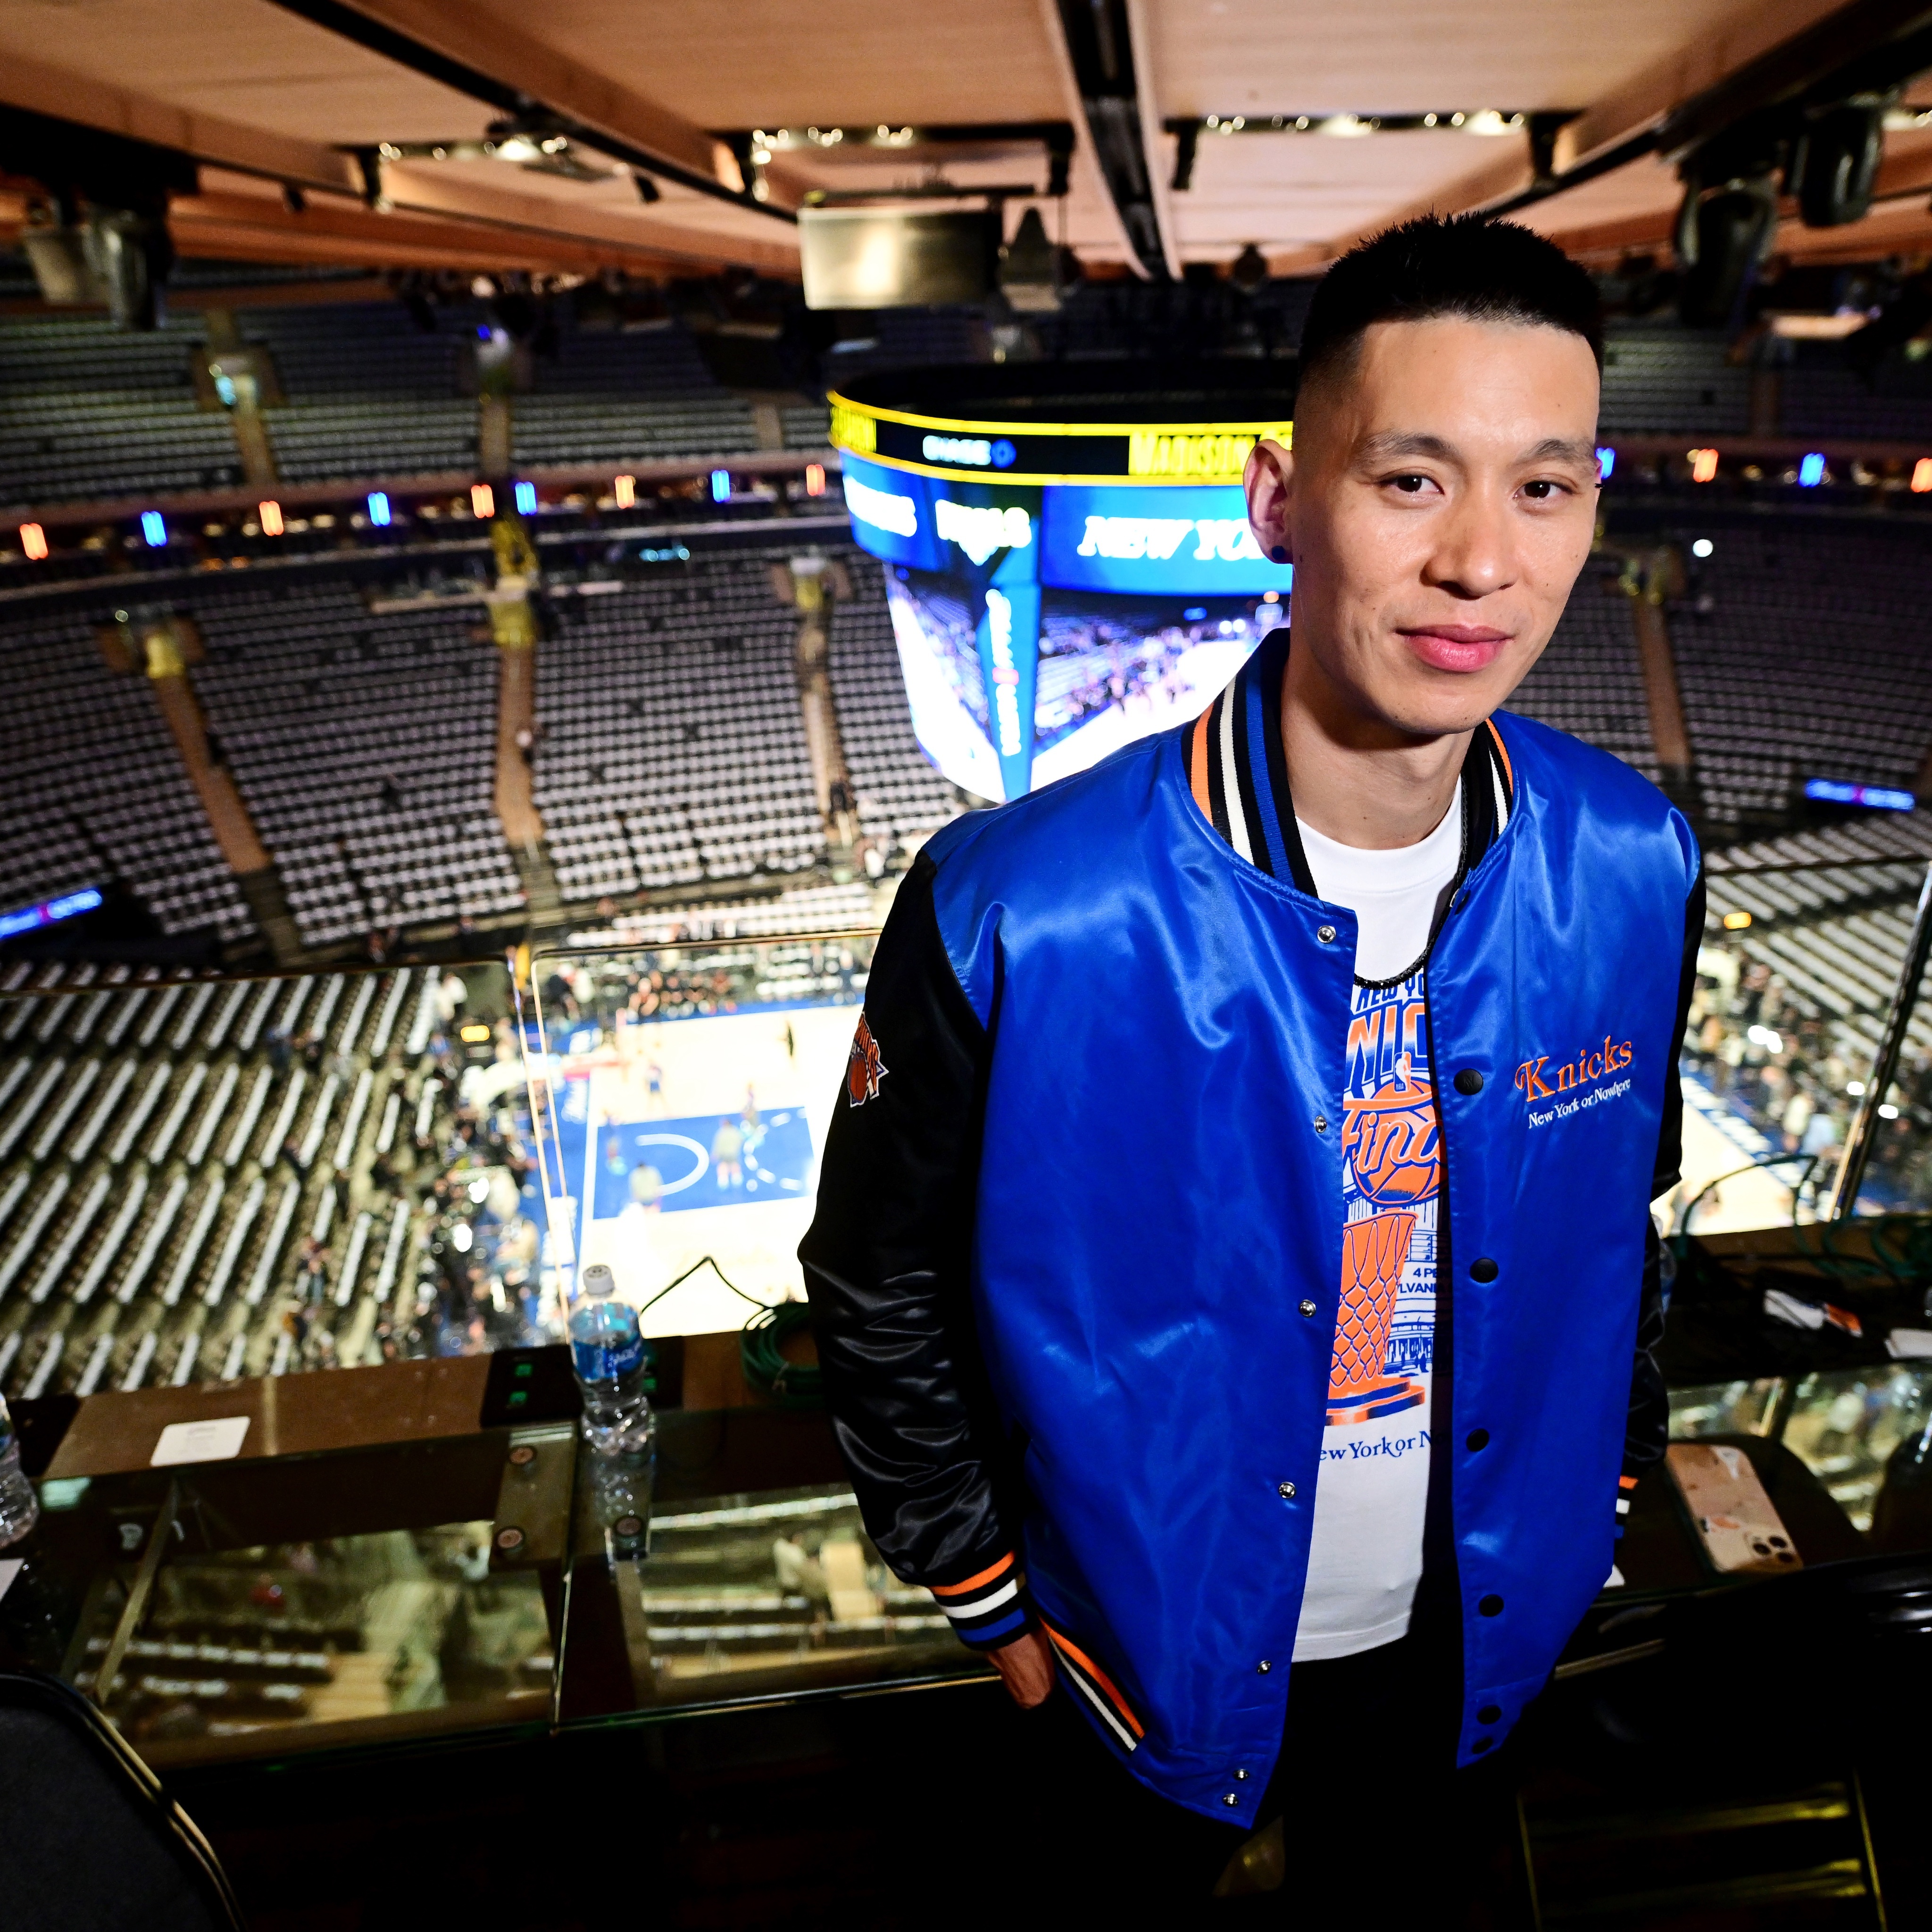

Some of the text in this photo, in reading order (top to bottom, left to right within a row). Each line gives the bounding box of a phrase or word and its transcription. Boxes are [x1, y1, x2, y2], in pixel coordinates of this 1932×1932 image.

[1077, 516, 1194, 559] NEW
[1193, 518, 1266, 561] YO
[1515, 1035, 1632, 1102] Knicks
[1528, 1078, 1631, 1129] New York or Nowhere
[1413, 1267, 1422, 1277] 4
[1348, 1436, 1402, 1457] York
[1395, 1438, 1416, 1451] or
